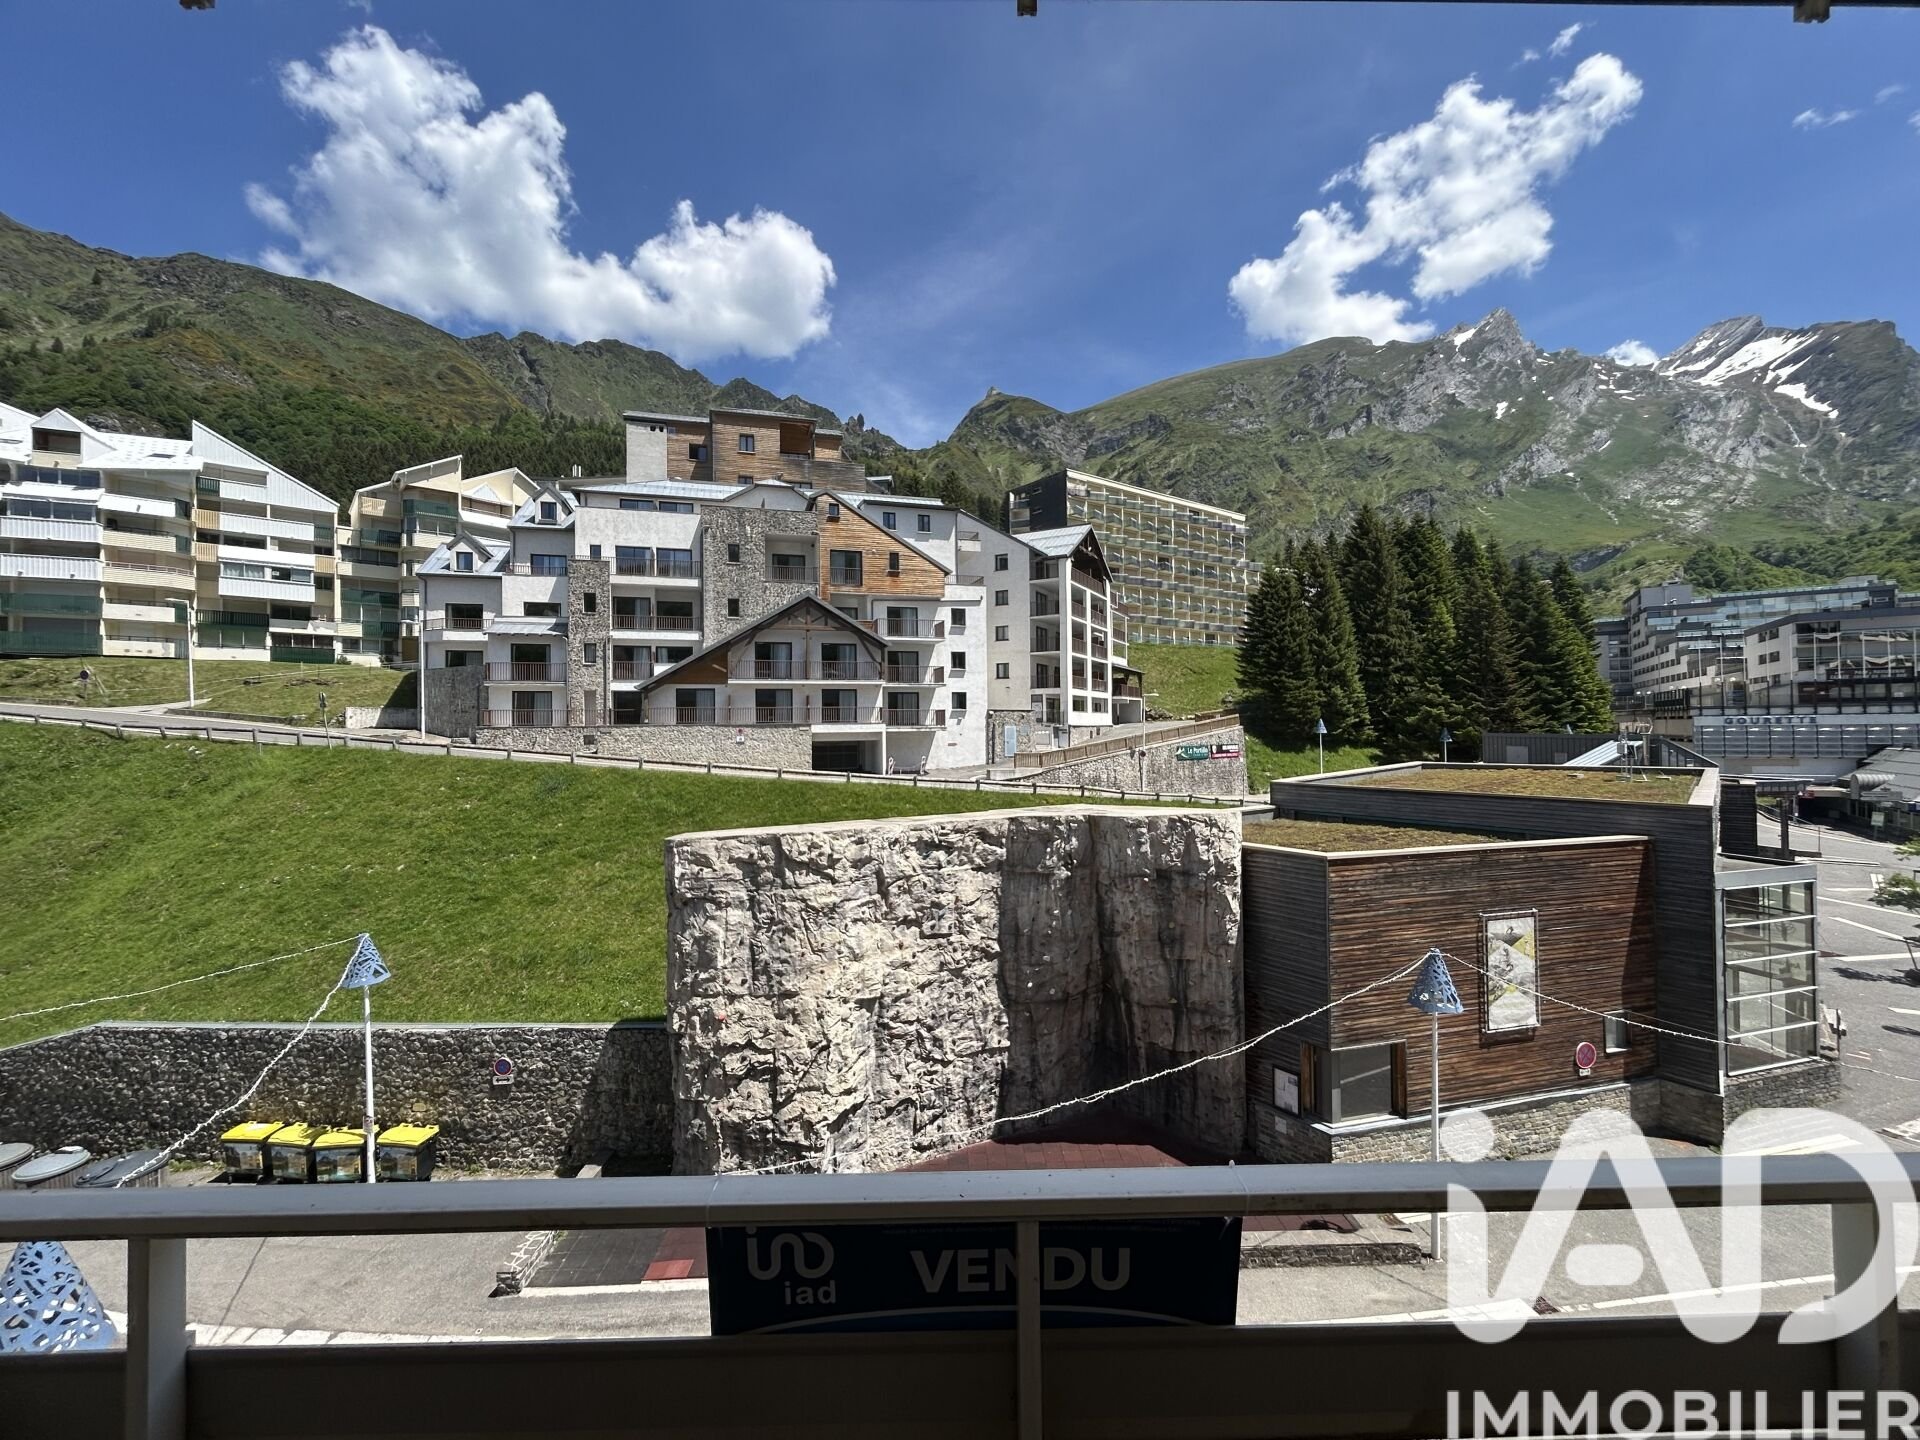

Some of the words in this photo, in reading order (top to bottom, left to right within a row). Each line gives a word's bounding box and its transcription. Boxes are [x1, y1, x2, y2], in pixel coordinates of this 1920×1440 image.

[1724, 716, 1817, 725] GOURETTE
[910, 1246, 1131, 1294] VENDU
[784, 1281, 837, 1305] iad
